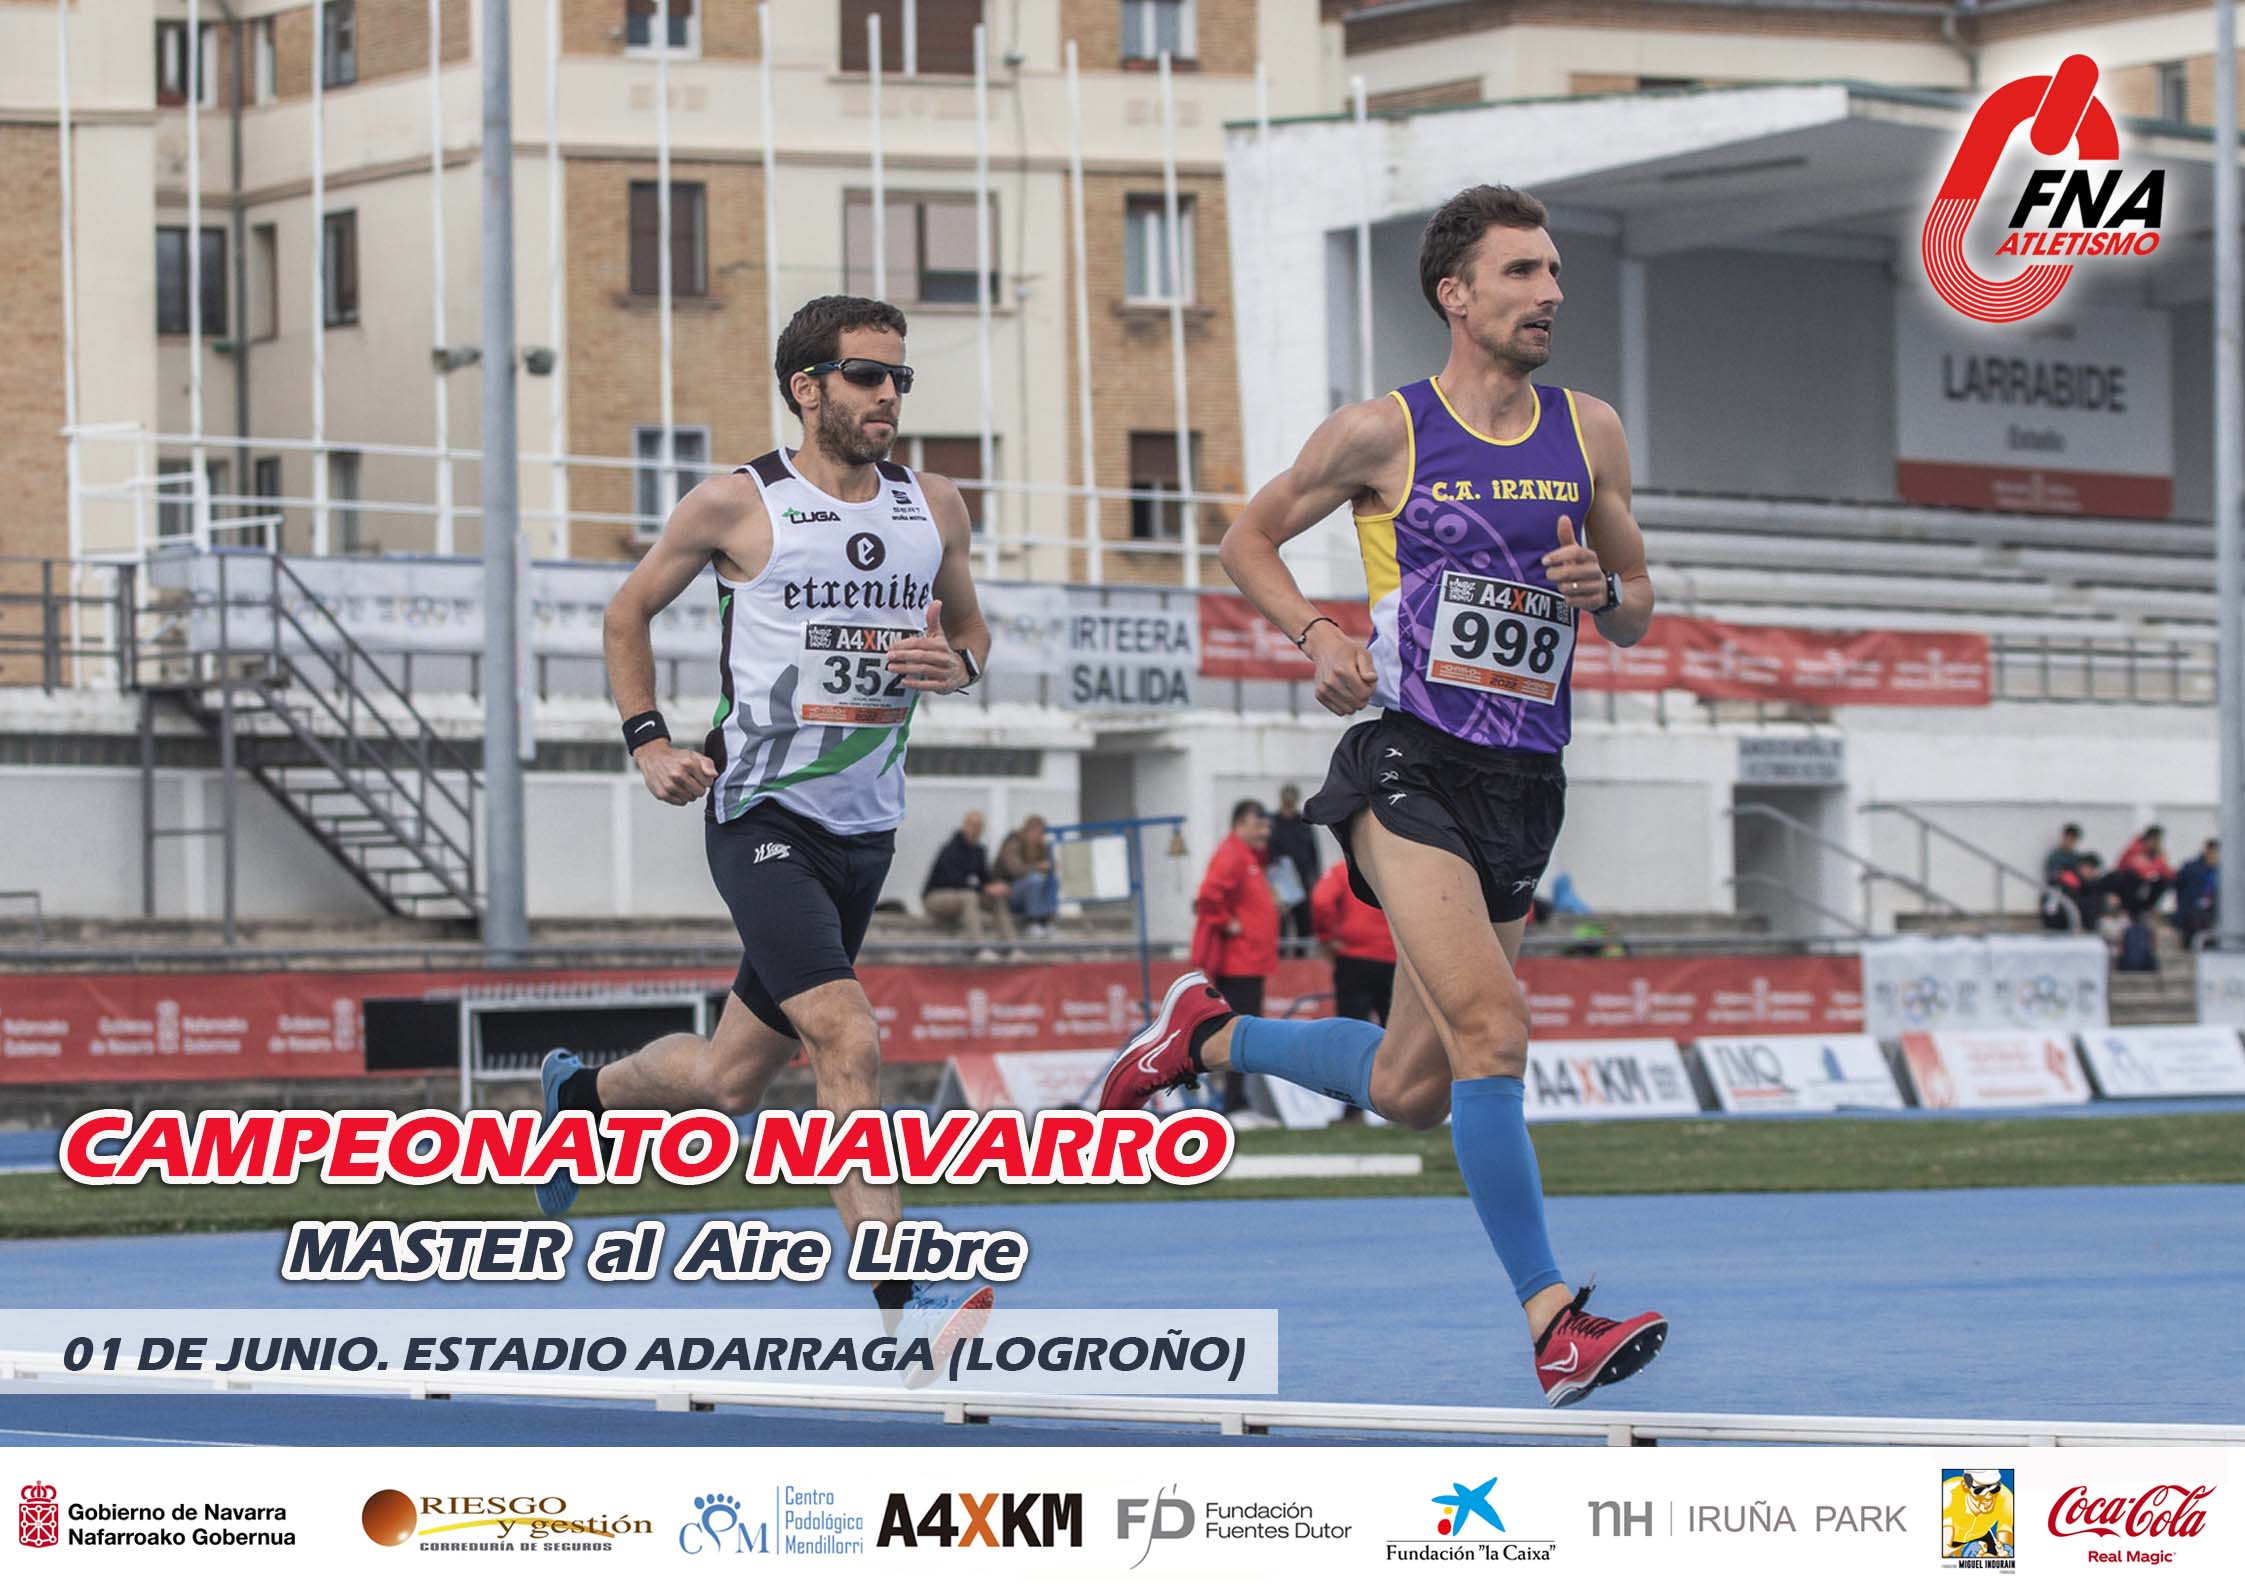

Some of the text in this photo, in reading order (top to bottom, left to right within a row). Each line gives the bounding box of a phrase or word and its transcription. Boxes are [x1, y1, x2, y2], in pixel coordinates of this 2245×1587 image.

[1942, 353, 2127, 414] LARRABIDE
[1432, 481, 1481, 501] C.A.
[1479, 583, 1551, 618] A4XKM
[1071, 614, 1190, 652] IRTEERA
[1450, 611, 1560, 674] 998
[822, 655, 907, 697] 352
[1072, 664, 1190, 705] SALIDA
